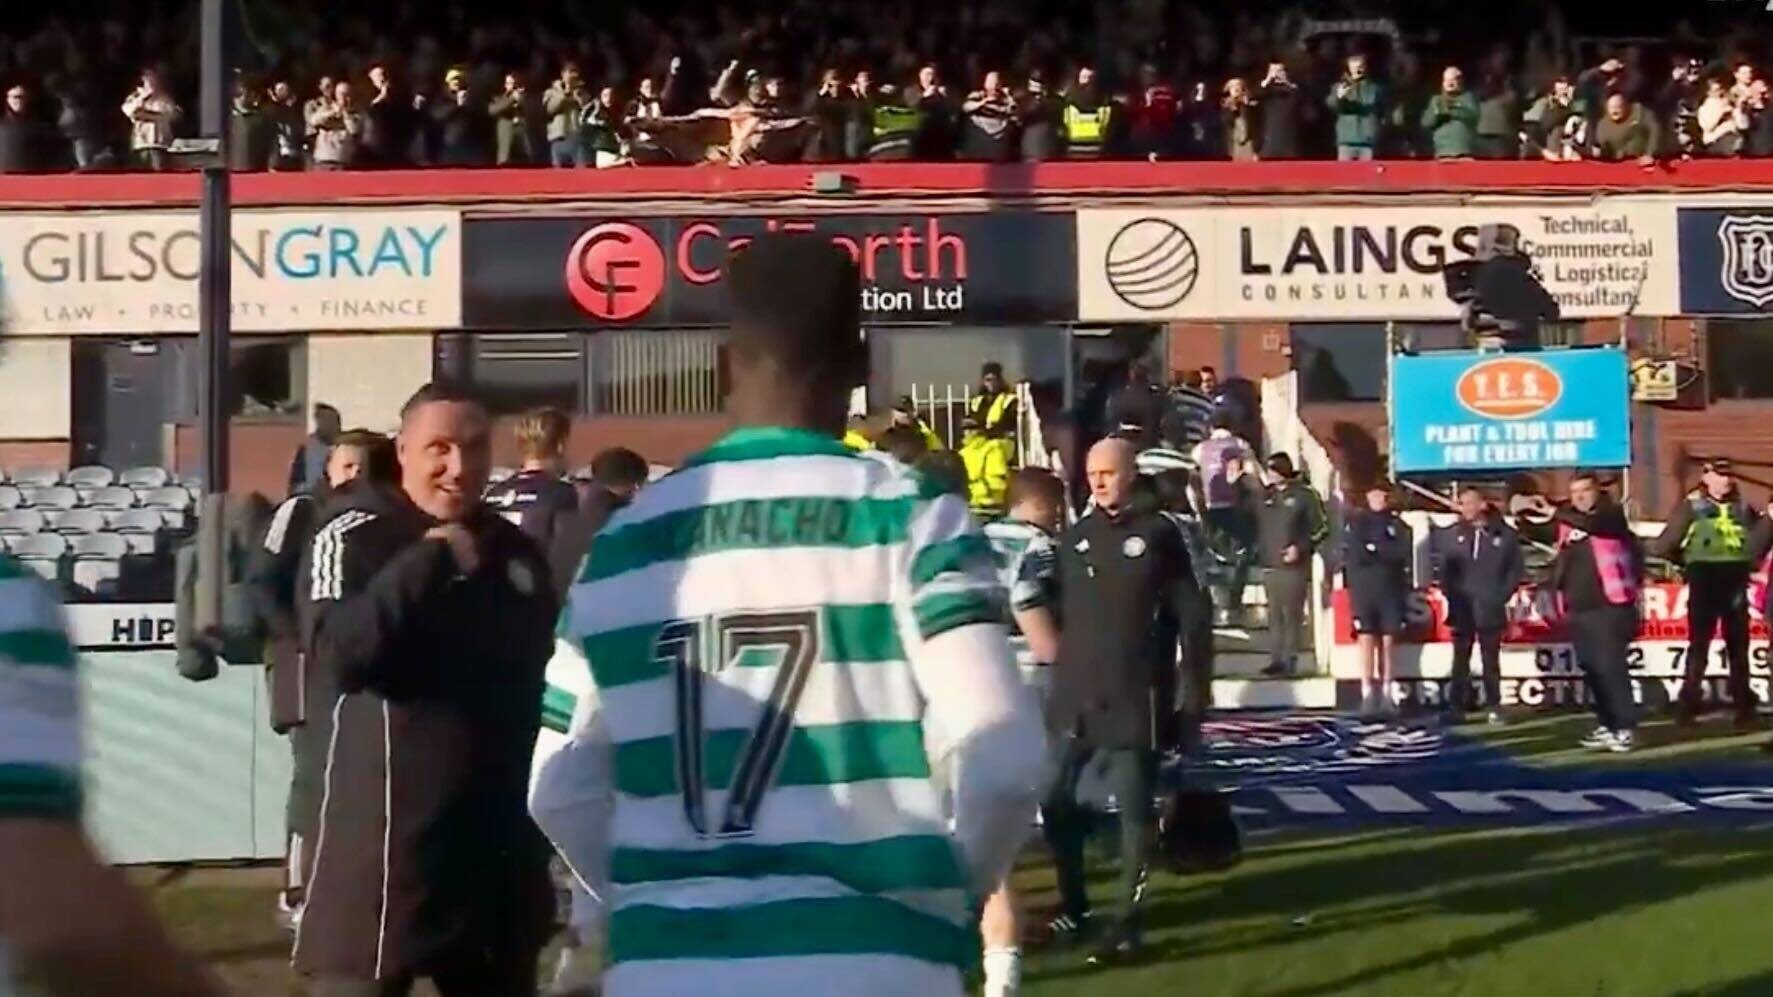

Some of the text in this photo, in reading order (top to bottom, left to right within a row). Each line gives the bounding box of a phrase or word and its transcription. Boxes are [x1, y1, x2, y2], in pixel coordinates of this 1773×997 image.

[1540, 214, 1634, 236] Technical,
[1554, 261, 1648, 286] Logistical
[861, 286, 963, 311] tion Ltd
[1241, 284, 1434, 301] CONSULTAN
[44, 298, 427, 322] LAW PROTY FINANCE
[1425, 423, 1483, 443] PLANT
[652, 607, 824, 841] 17
